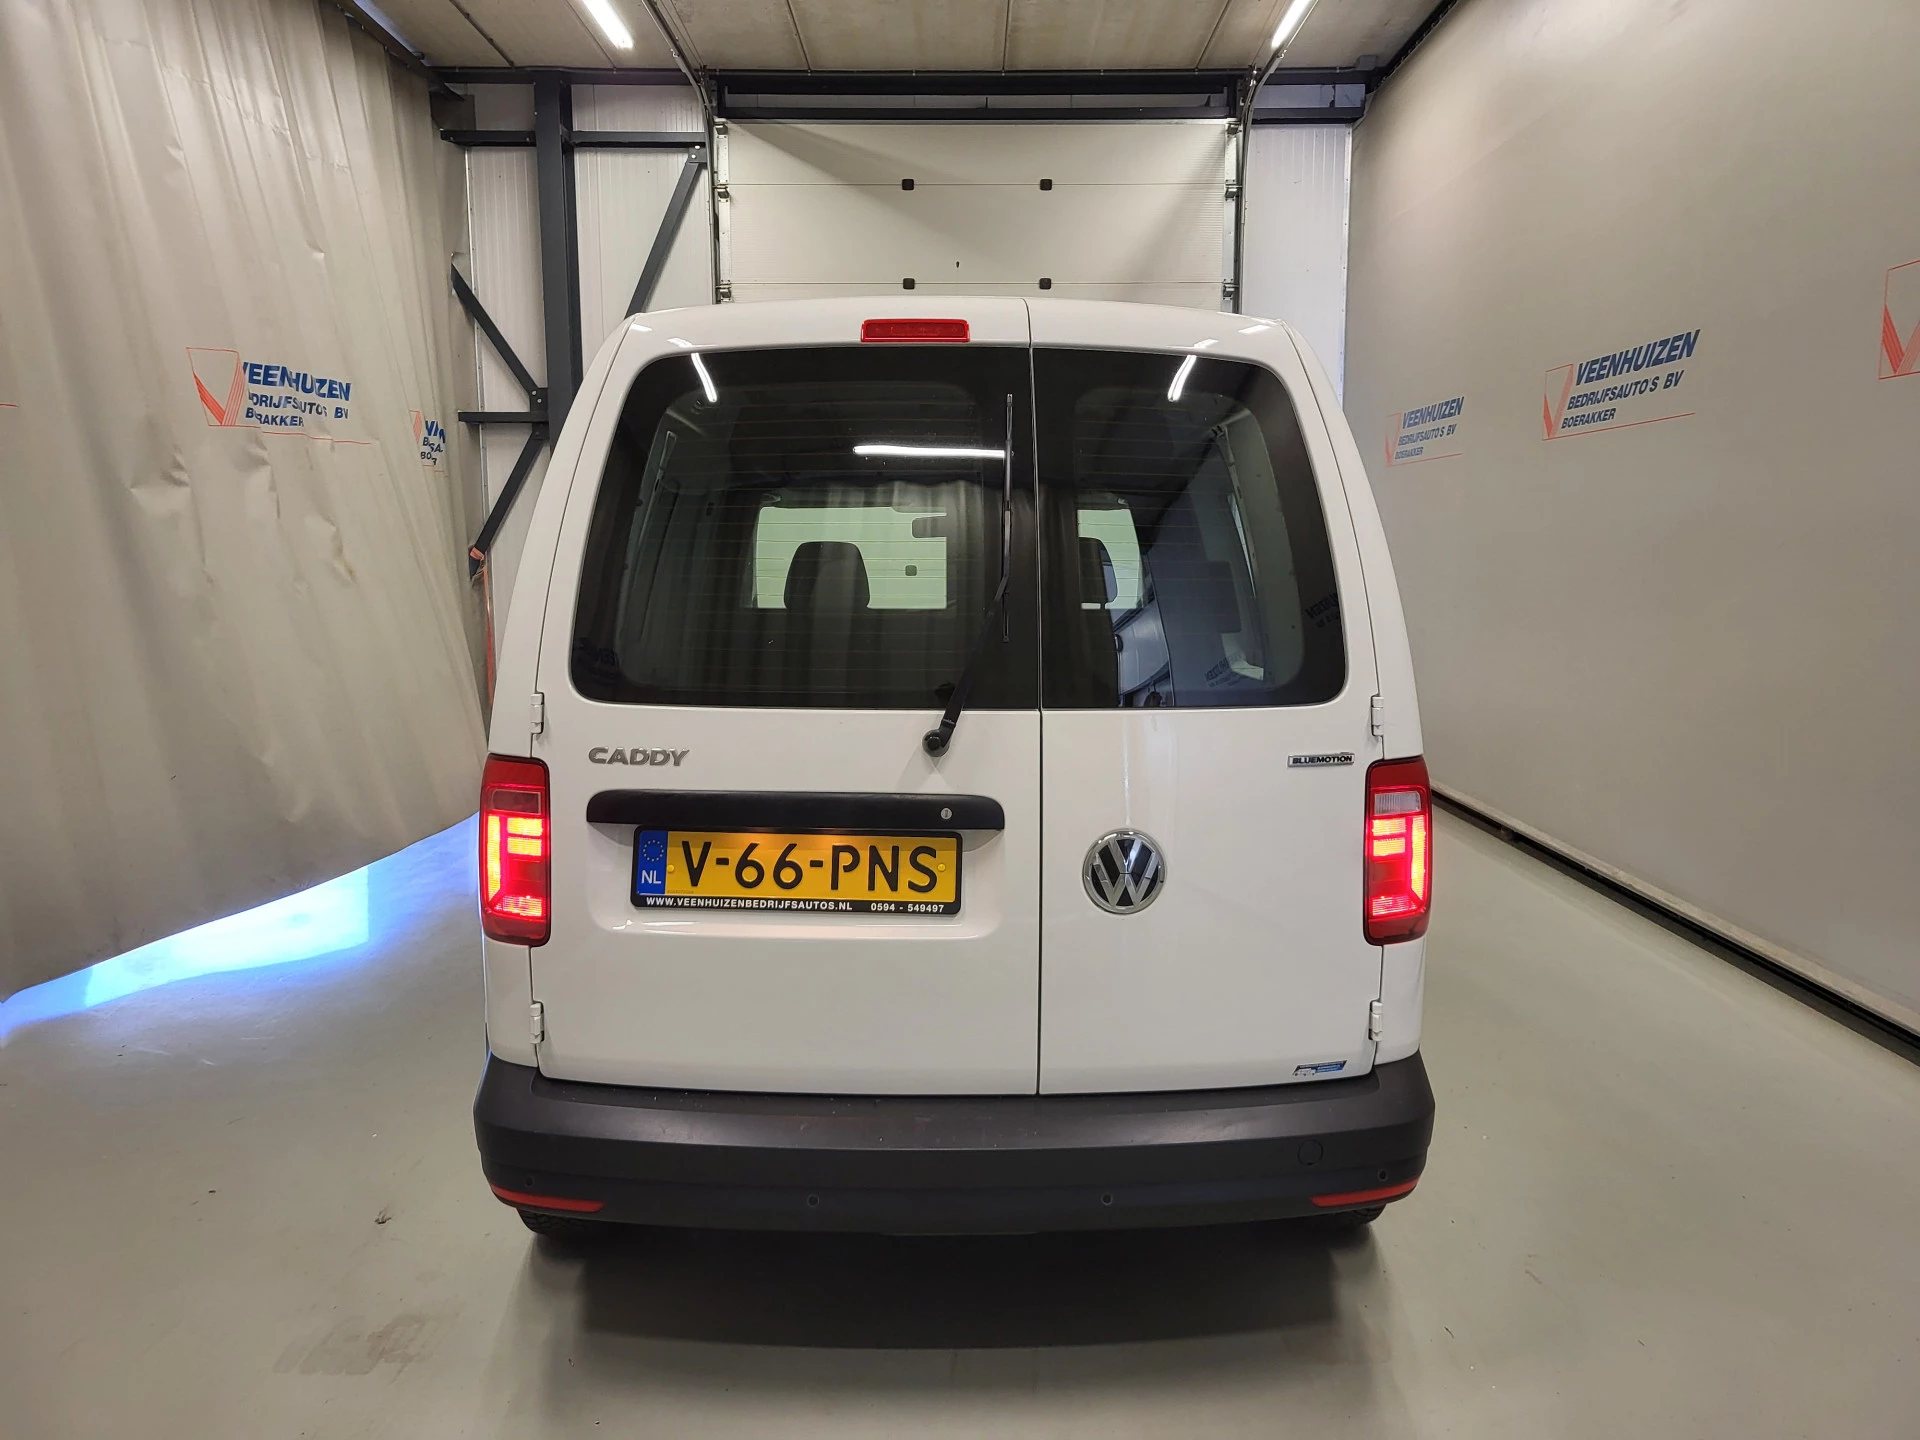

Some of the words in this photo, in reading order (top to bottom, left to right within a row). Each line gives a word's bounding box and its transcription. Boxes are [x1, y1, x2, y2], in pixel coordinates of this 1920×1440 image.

[1576, 329, 1700, 386] VEENHUIZEN
[1663, 370, 1684, 389] BV
[1403, 396, 1464, 429] VEENHUIZEN
[1561, 408, 1616, 429] BOERAKKER
[588, 746, 690, 766] CADDY
[1292, 755, 1353, 764] BLUEMOTION
[681, 840, 938, 893] V-66-PNS
[641, 870, 662, 884] NL
[646, 897, 853, 911] WWW.VEENHUIZENBEDRIJFSAUTOS.NL
[870, 902, 896, 912] 0594
[907, 903, 945, 913] 549497
